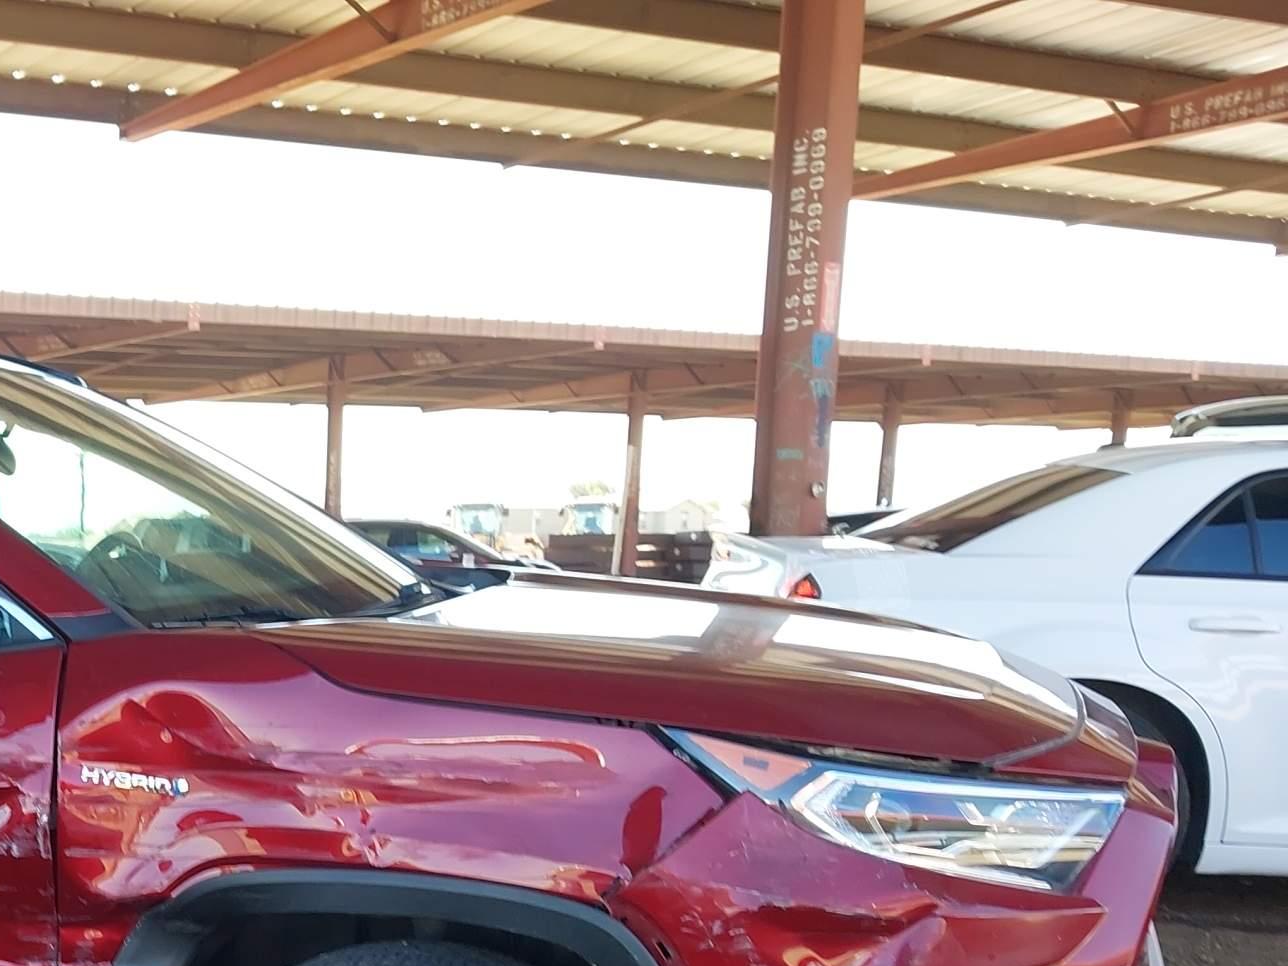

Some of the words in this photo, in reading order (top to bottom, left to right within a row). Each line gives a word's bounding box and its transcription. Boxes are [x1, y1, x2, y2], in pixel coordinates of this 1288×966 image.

[792, 128, 810, 176] INC.
[787, 186, 807, 276] PREFAB
[784, 287, 801, 332] U.S.
[80, 764, 173, 795] HYBRID
